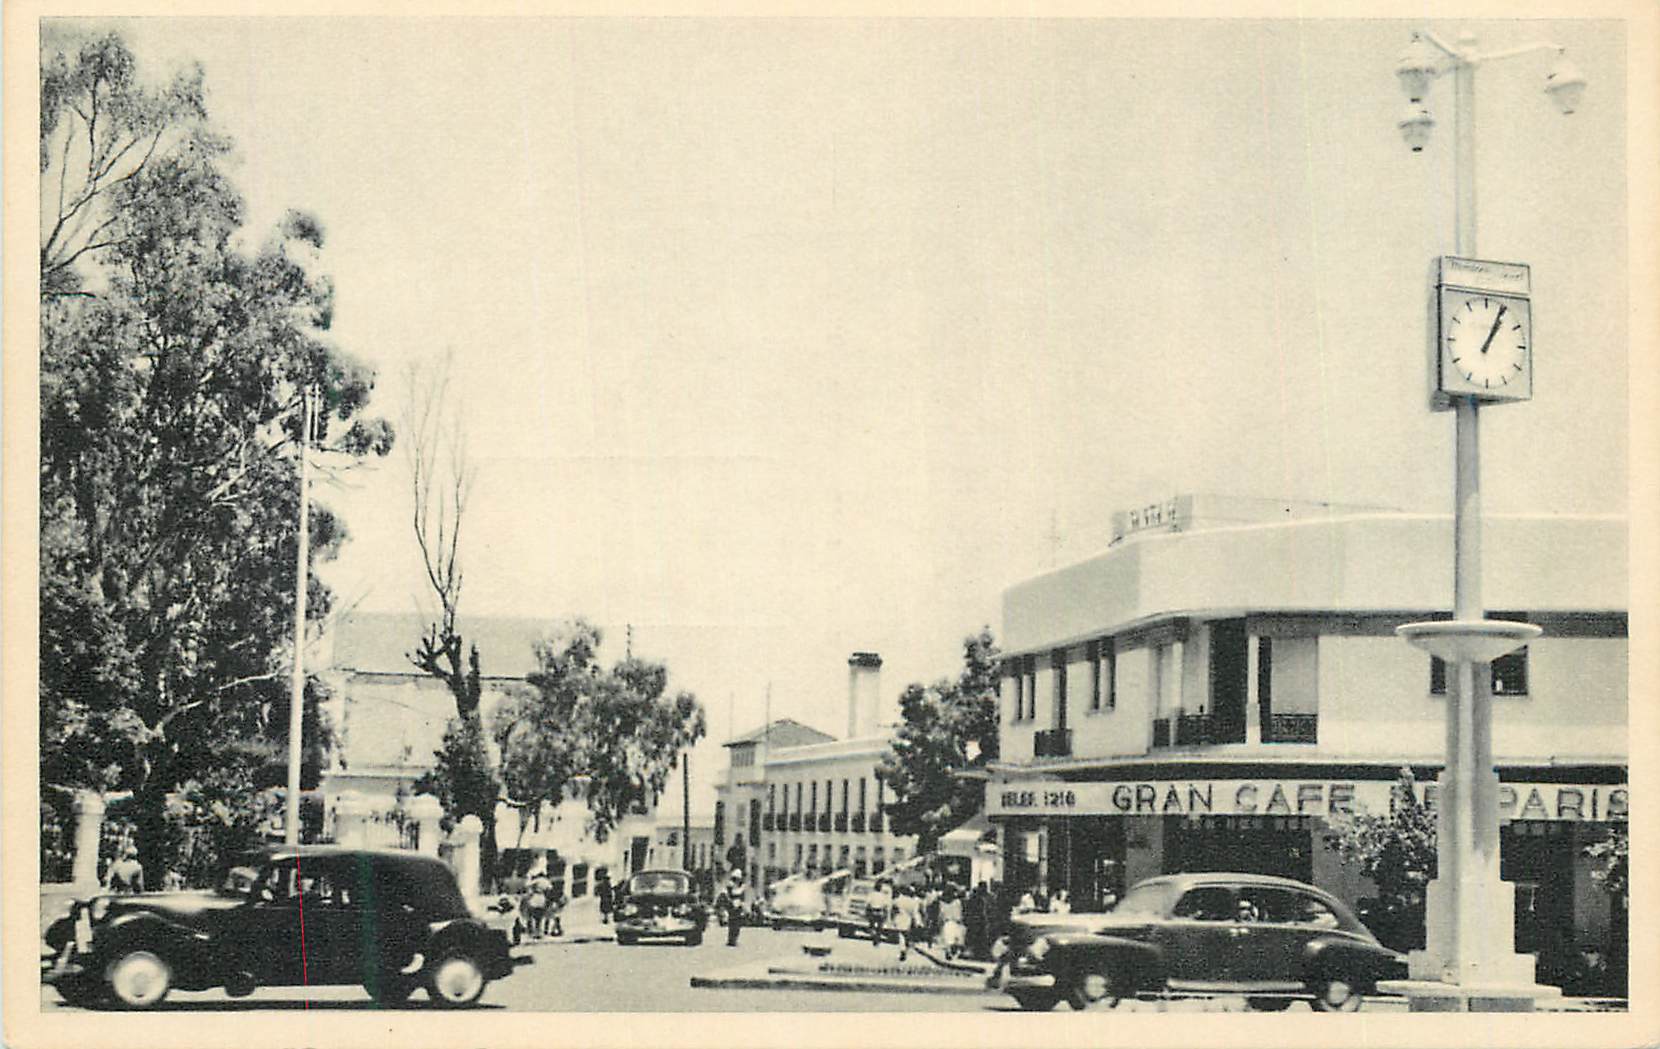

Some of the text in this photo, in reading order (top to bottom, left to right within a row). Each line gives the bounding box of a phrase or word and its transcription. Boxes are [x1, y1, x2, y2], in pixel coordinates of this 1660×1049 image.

[1112, 783, 1212, 816] GRAN
[1236, 784, 1356, 817] CAFE
[1499, 787, 1627, 819] PARIS
